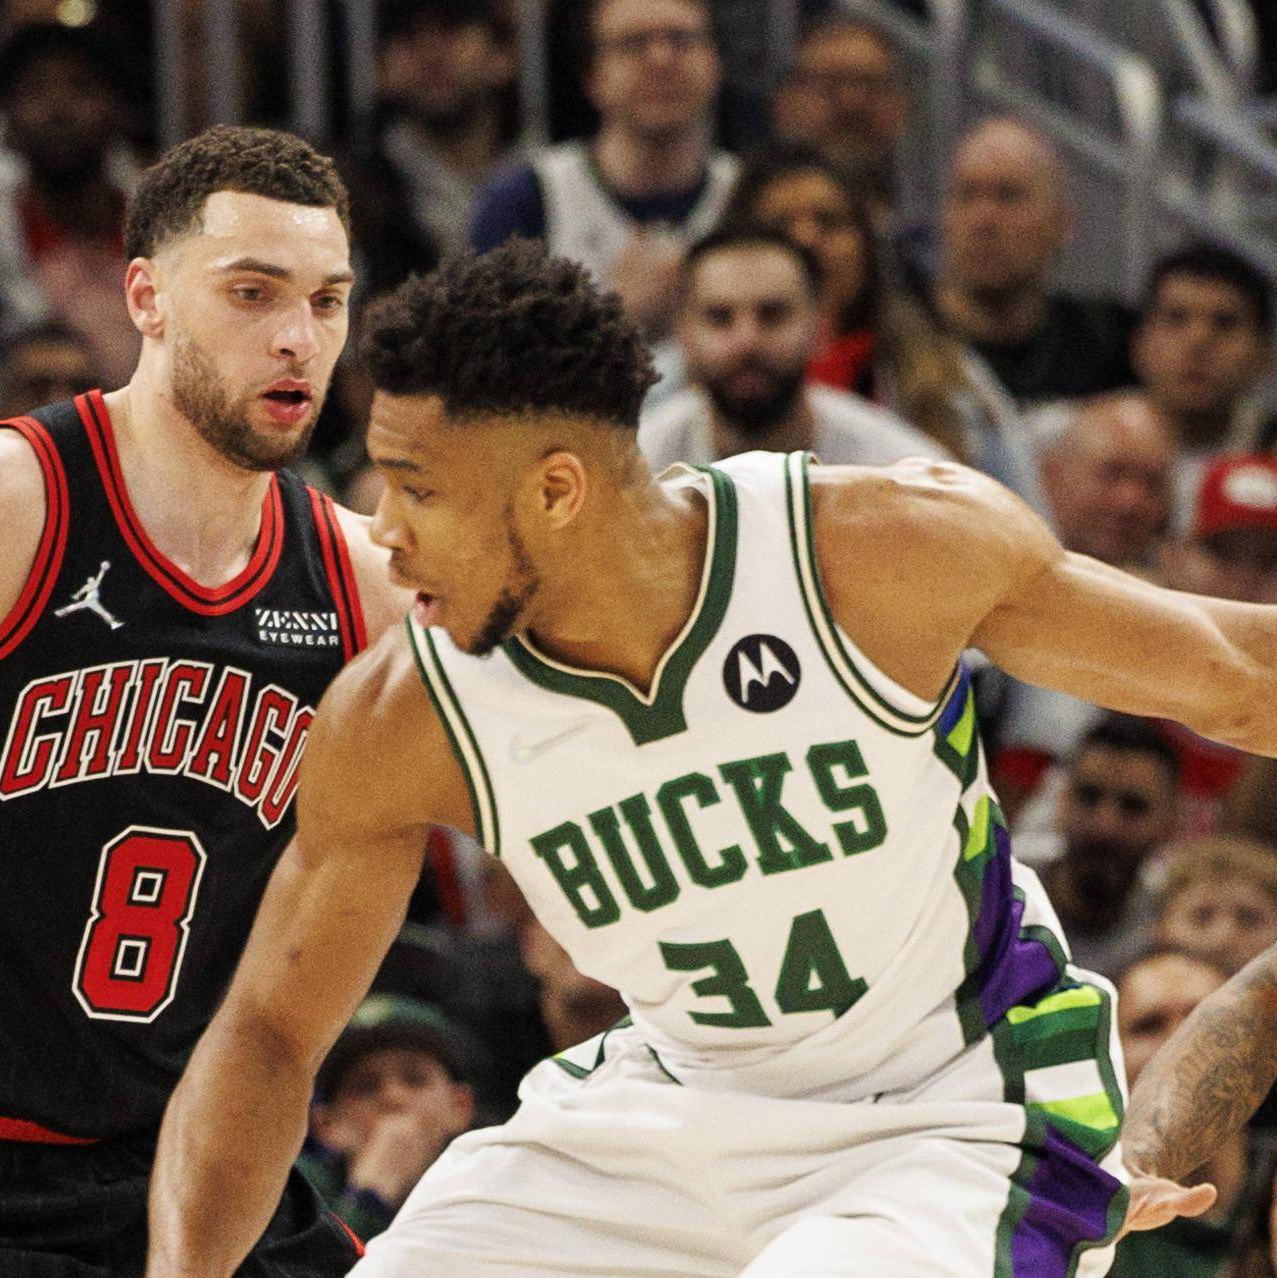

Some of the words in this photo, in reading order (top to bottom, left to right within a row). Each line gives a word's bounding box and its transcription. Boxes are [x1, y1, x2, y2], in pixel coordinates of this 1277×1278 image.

[255, 608, 337, 631] ZENNI
[259, 630, 339, 646] EYEWEAR
[528, 739, 888, 930] BUCKS
[71, 825, 208, 1023] 8
[656, 908, 870, 1029] 34
